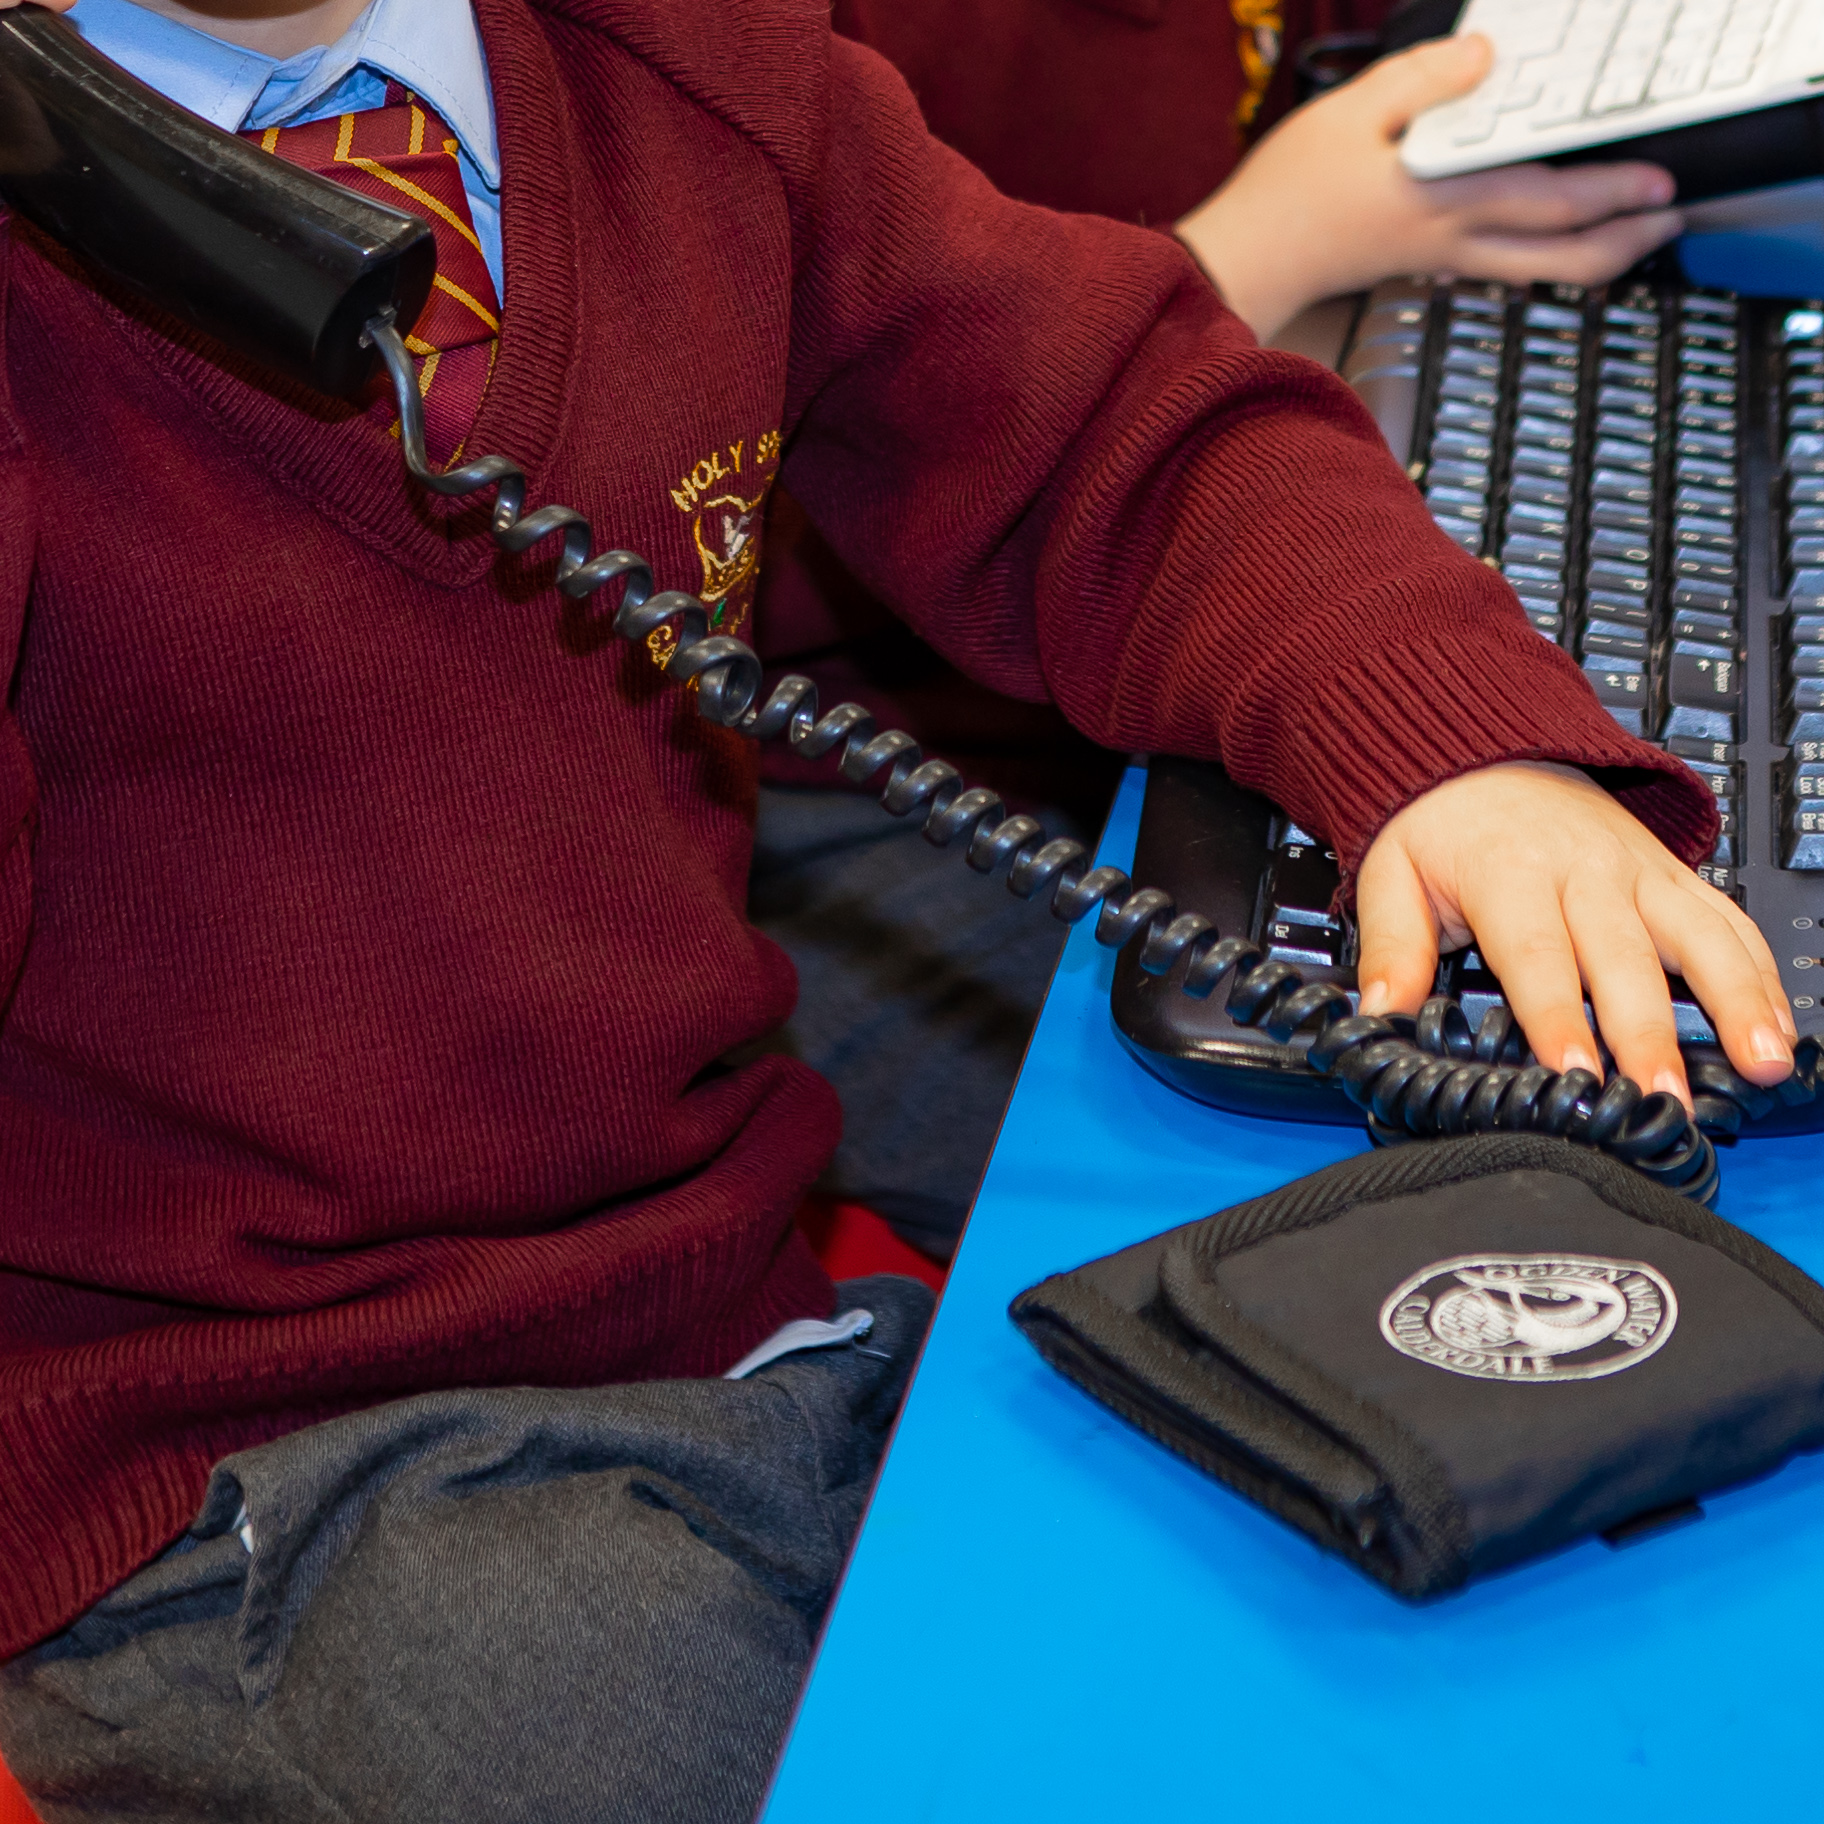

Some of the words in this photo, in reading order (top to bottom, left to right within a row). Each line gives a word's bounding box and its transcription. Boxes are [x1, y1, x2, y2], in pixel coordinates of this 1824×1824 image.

[670, 440, 744, 513] HOLY
[1626, 676, 1640, 692] Enter
[1711, 775, 1726, 794] Home
[1800, 776, 1814, 794] Lock
[1288, 846, 1304, 858] Ins
[1713, 869, 1728, 886] Num
[1274, 924, 1290, 938] Del
[1483, 1263, 1630, 1284] OGDEN
[1613, 1274, 1662, 1348] WATER
[1393, 1294, 1555, 1375] CALDERDALE
